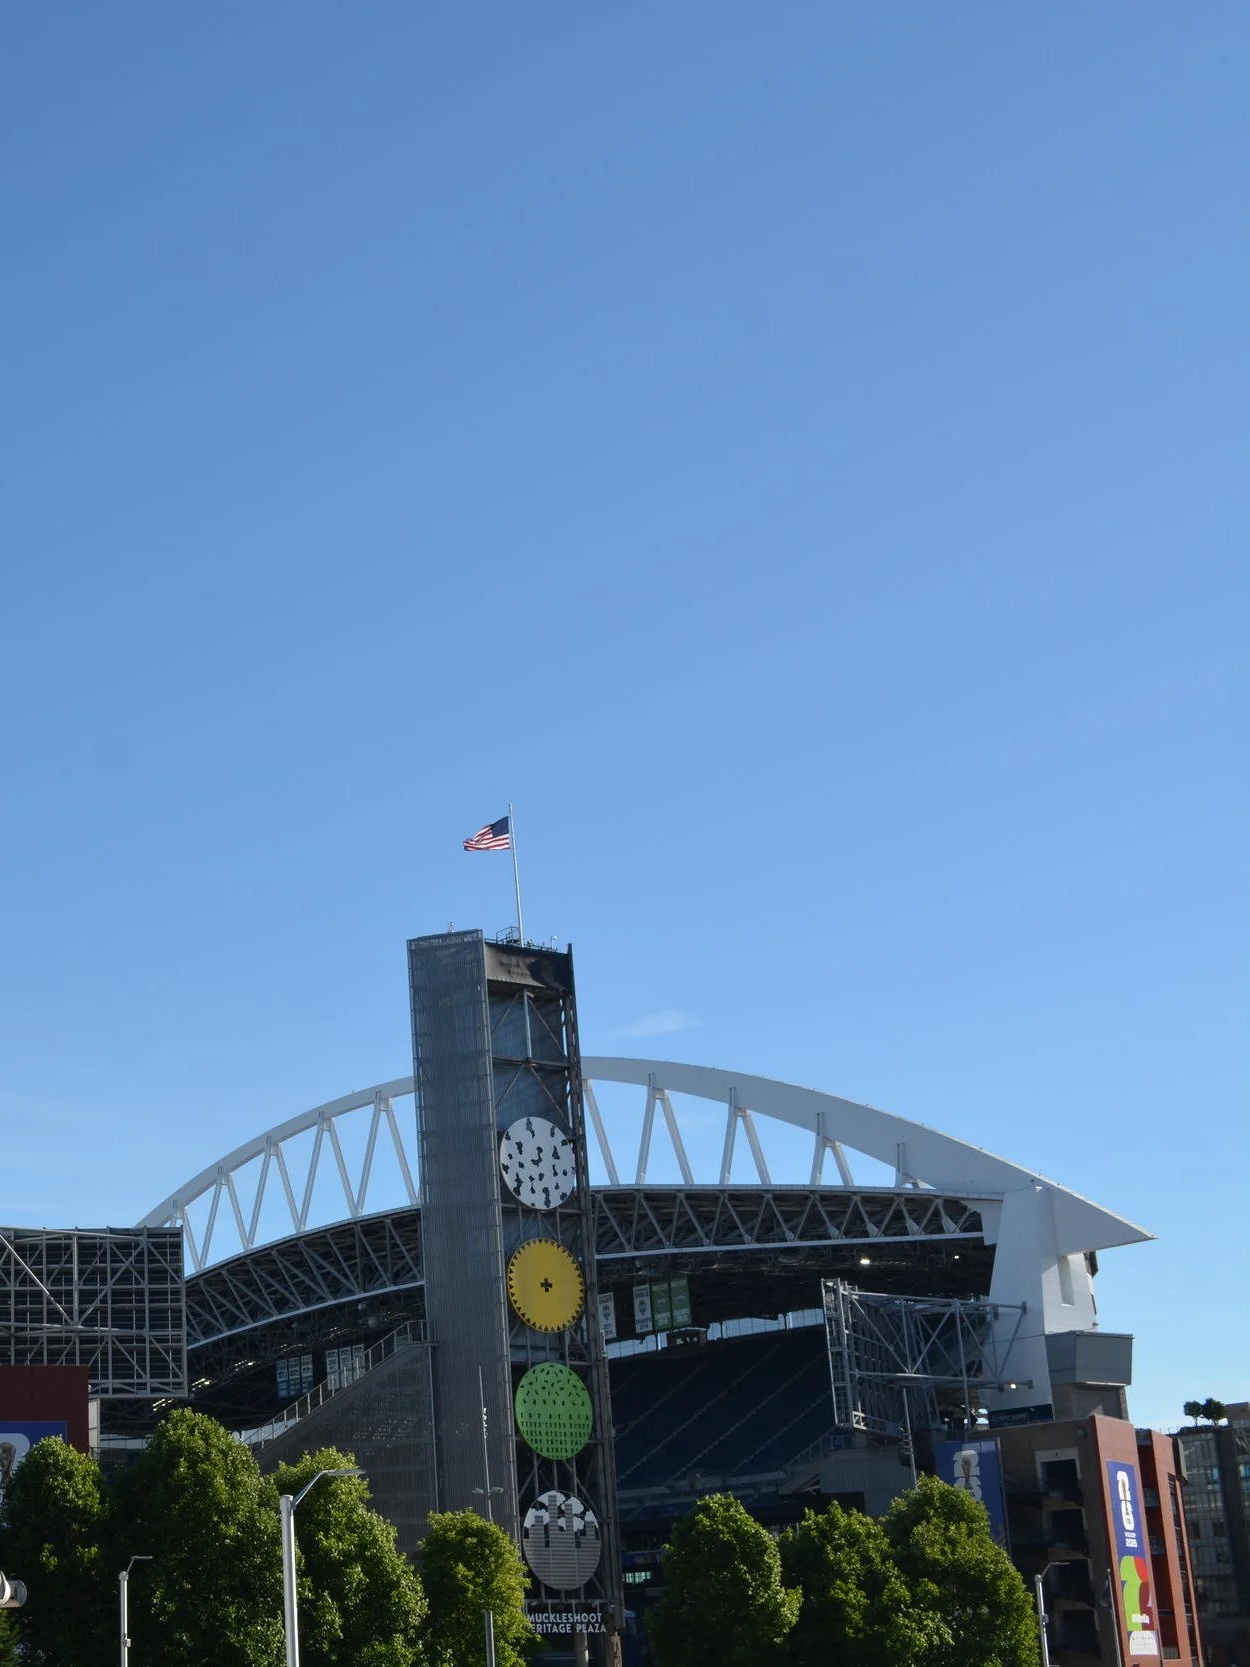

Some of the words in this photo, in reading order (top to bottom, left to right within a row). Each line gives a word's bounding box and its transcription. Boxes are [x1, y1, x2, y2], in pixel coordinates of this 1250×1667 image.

[527, 1612, 602, 1623] MUCKLESHOOT
[530, 1623, 572, 1633] ERITAGE
[576, 1623, 607, 1633] PLAZA
